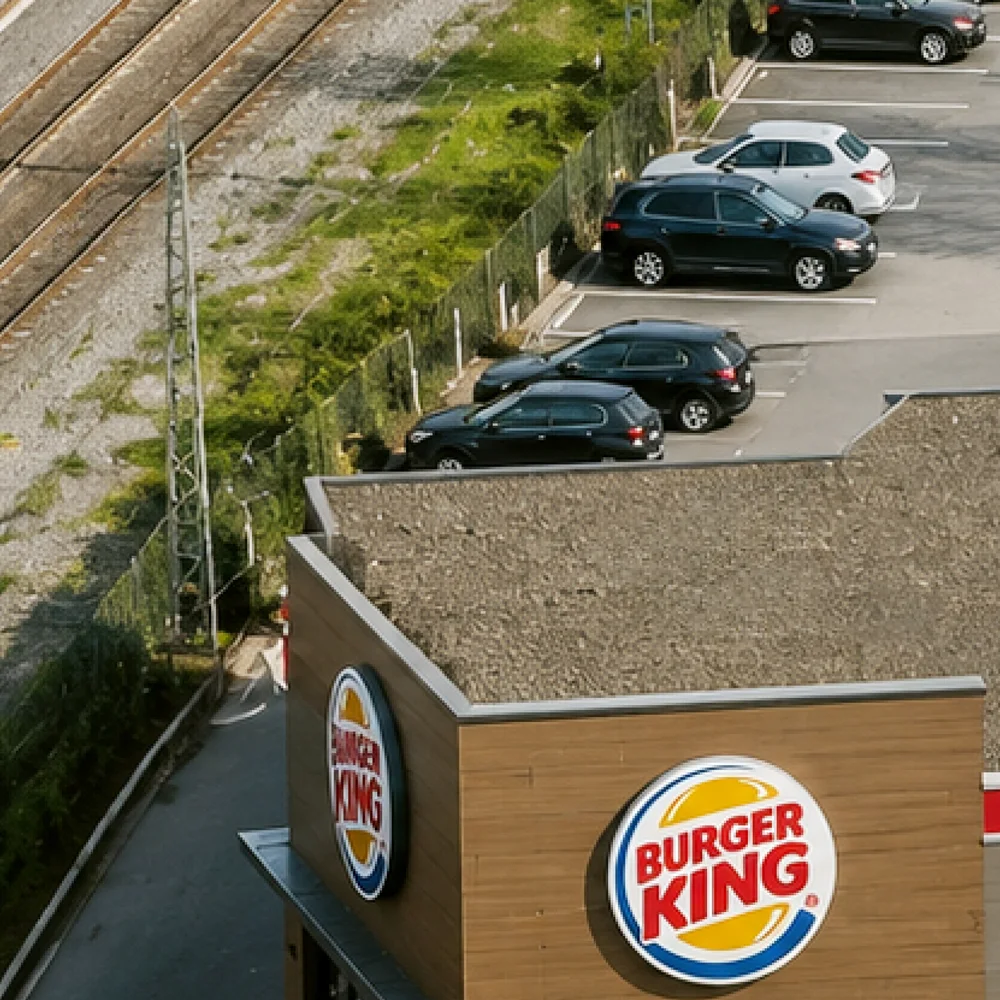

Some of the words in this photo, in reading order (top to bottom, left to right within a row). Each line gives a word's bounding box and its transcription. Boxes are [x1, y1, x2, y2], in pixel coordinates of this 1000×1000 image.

[333, 769, 382, 832] KING
[636, 803, 805, 885] BURGER
[643, 841, 809, 942] KING
